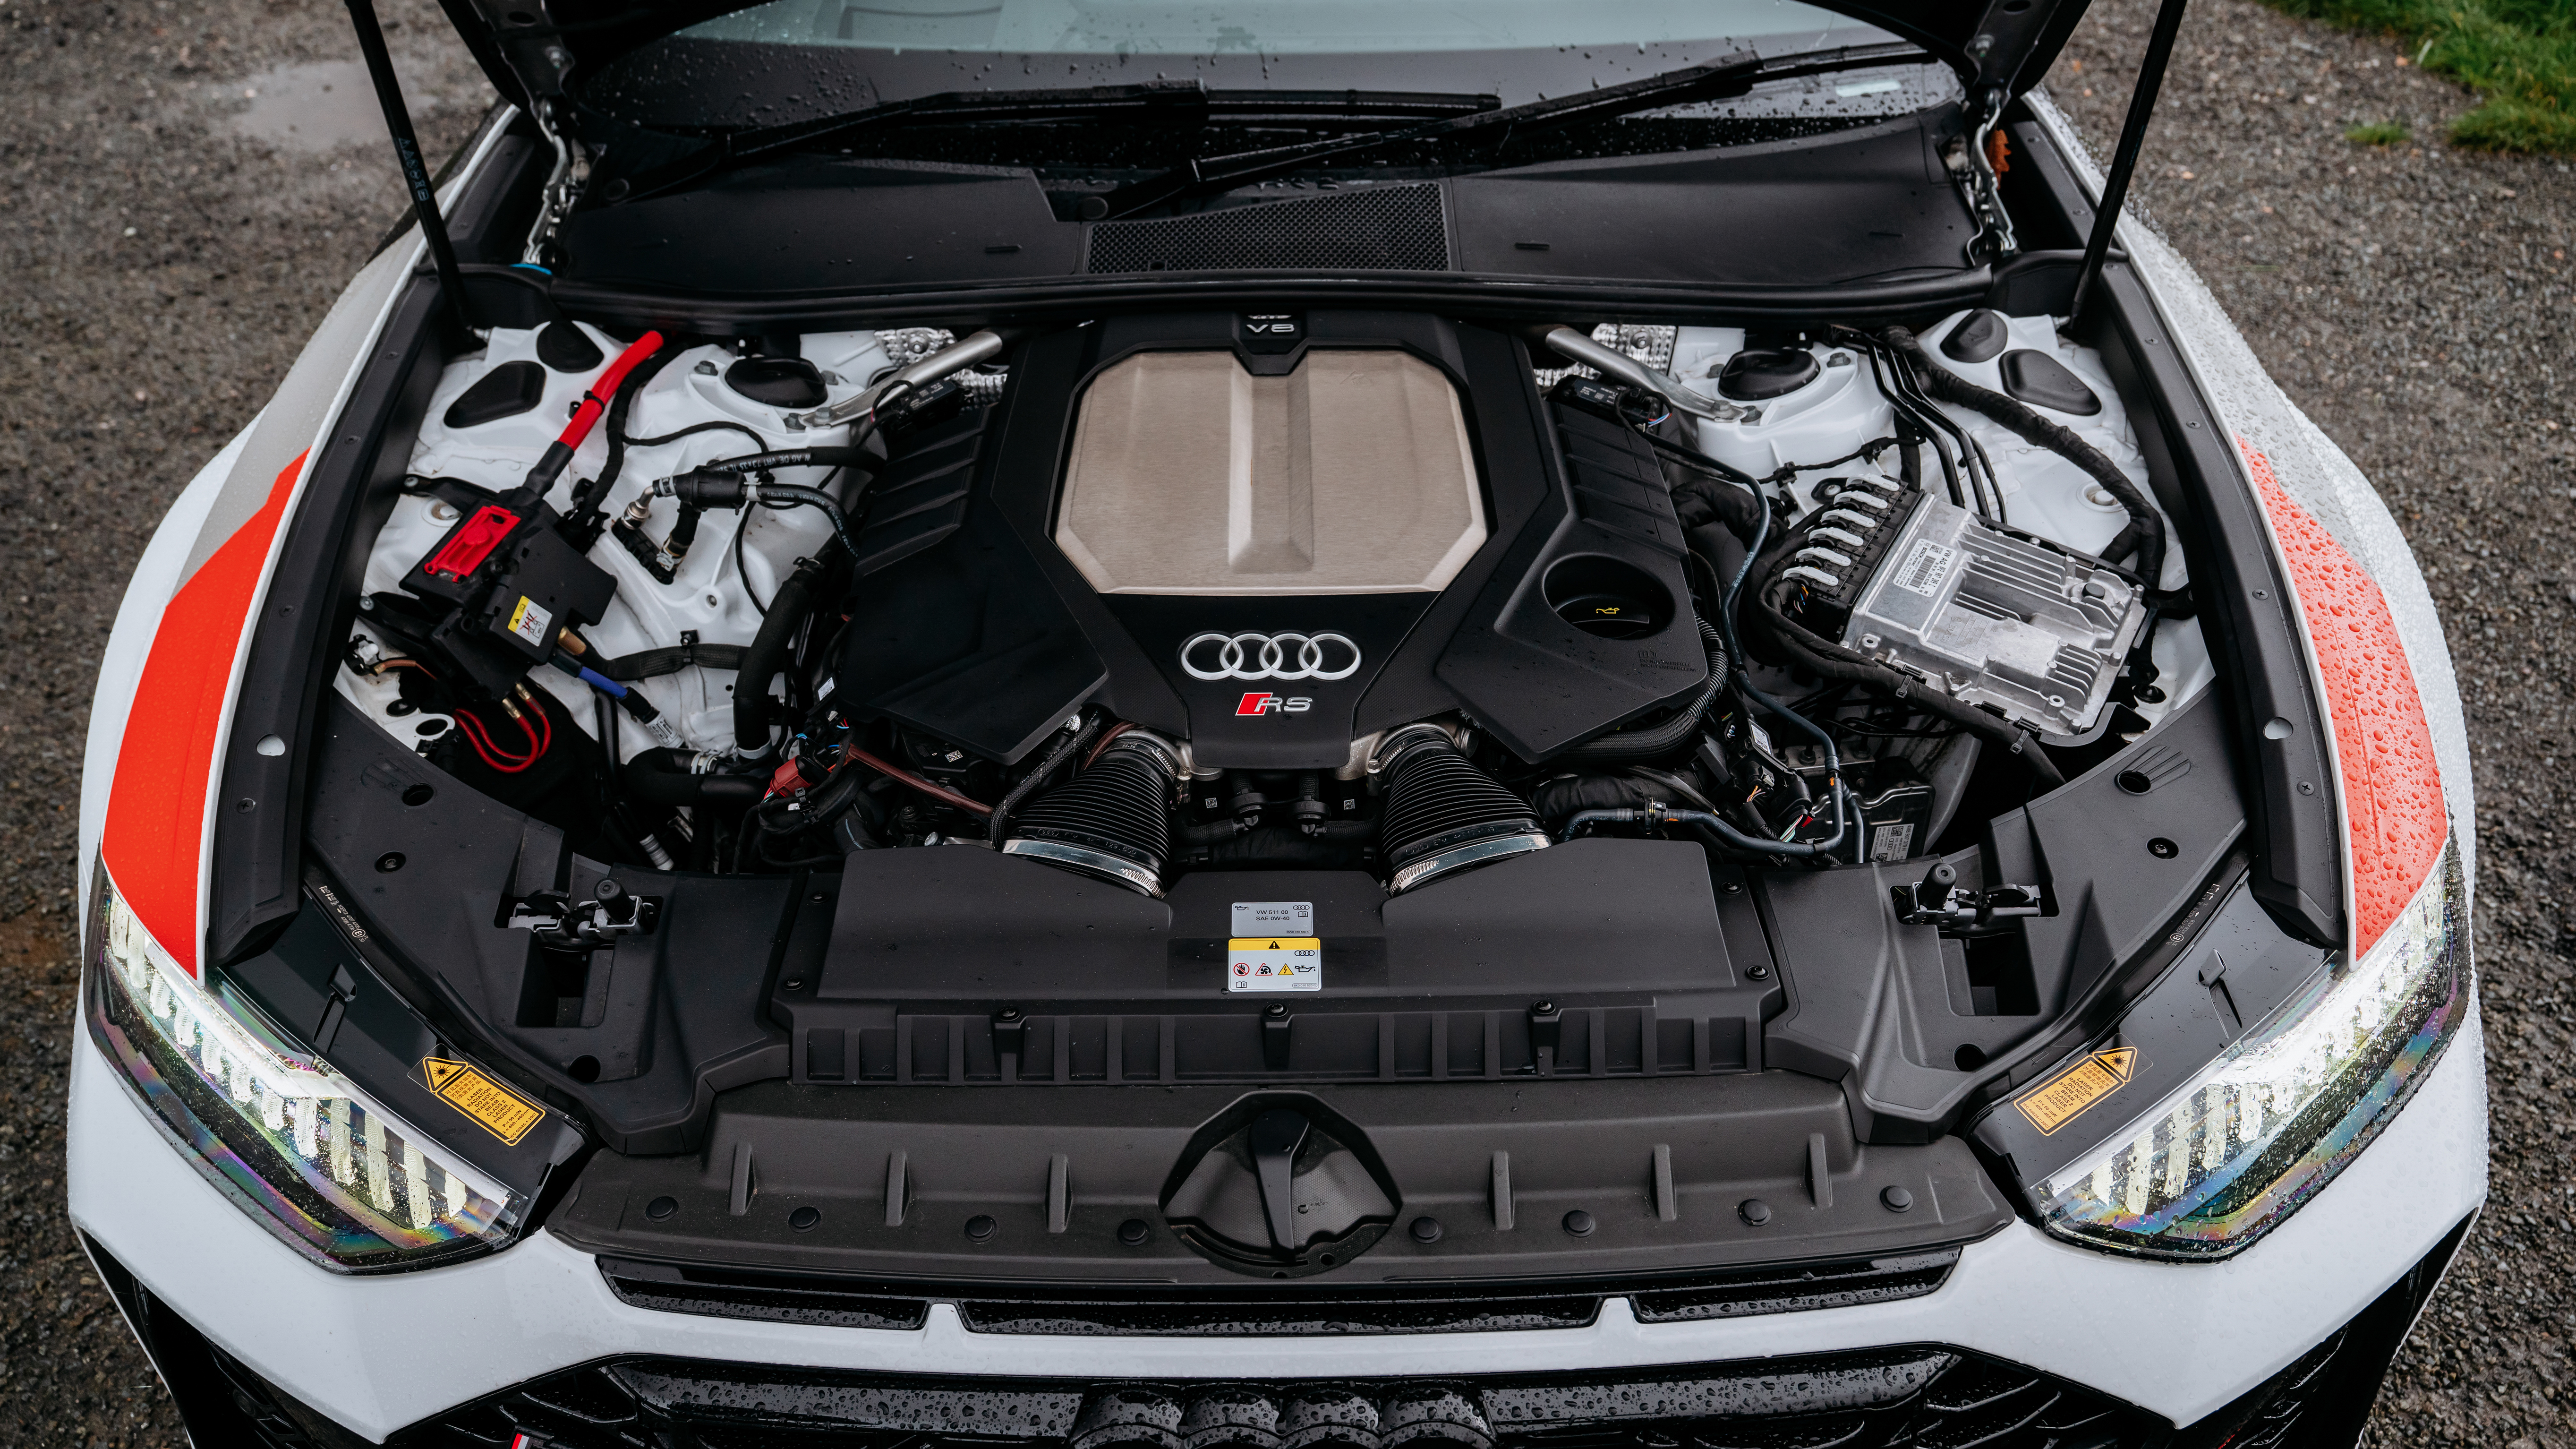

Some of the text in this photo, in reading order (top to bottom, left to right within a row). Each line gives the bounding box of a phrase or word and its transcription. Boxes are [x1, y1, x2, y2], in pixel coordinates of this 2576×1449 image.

[1246, 324, 1295, 333] V8
[1918, 547, 1928, 558] BOSCH
[1943, 549, 1953, 558] VW
[1939, 557, 1948, 565] AG
[1254, 697, 1313, 712] RS
[341, 915, 349, 925] 4708
[347, 922, 355, 931] 4706
[346, 913, 354, 923] 4707
[2181, 926, 2189, 935] 4706
[2187, 918, 2195, 928] 4708
[2068, 1077, 2093, 1097] RADIATION
[2076, 1077, 2093, 1091] LASER
[466, 1087, 492, 1107] RADIATION
[467, 1088, 483, 1101] LASER
[481, 1092, 493, 1101] NOT
[2053, 1089, 2070, 1103] CLASS
[2058, 1081, 2085, 1103] STARE INTO
[2060, 1089, 2075, 1101] BEAM
[2074, 1088, 2086, 1097] NOT
[474, 1091, 501, 1114] STARE INTO
[485, 1099, 499, 1111] BEAM
[2044, 1094, 2066, 1114] PRODUCT
[2051, 1094, 2067, 1108] LASER
[486, 1102, 503, 1116] CLASS
[492, 1104, 508, 1118] LASER
[493, 1103, 516, 1123] PRODUCT
[2048, 1109, 2057, 1117] mW
[515, 1112, 537, 1132] 60825-1:2007
[2028, 1108, 2050, 1129] 60825-1:2007
